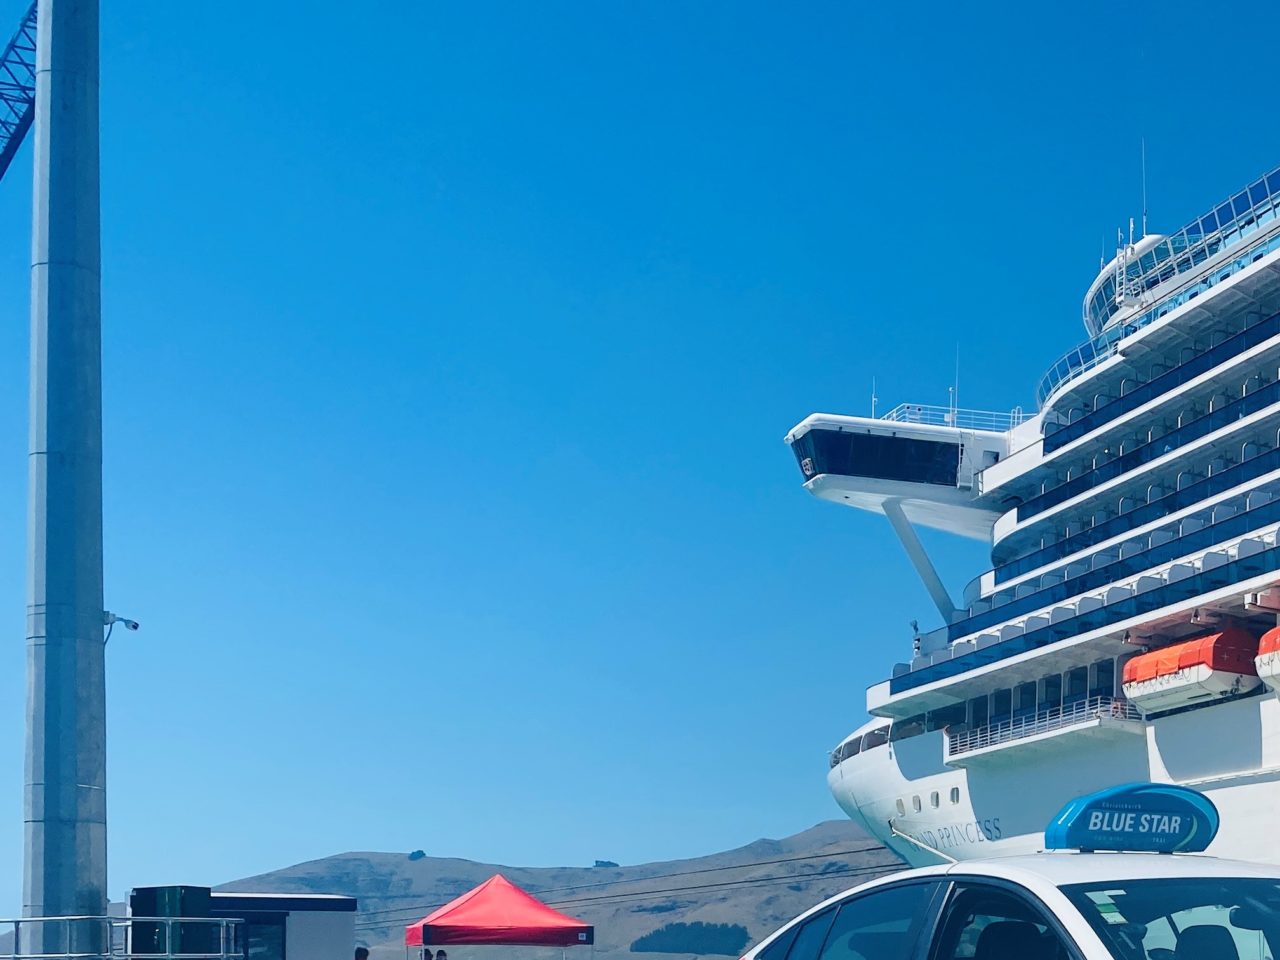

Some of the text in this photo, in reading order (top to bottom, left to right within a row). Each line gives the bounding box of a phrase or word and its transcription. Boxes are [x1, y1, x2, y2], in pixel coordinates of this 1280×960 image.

[938, 818, 1002, 848] PRINCESS
[1088, 811, 1181, 834] BLUE STAR
